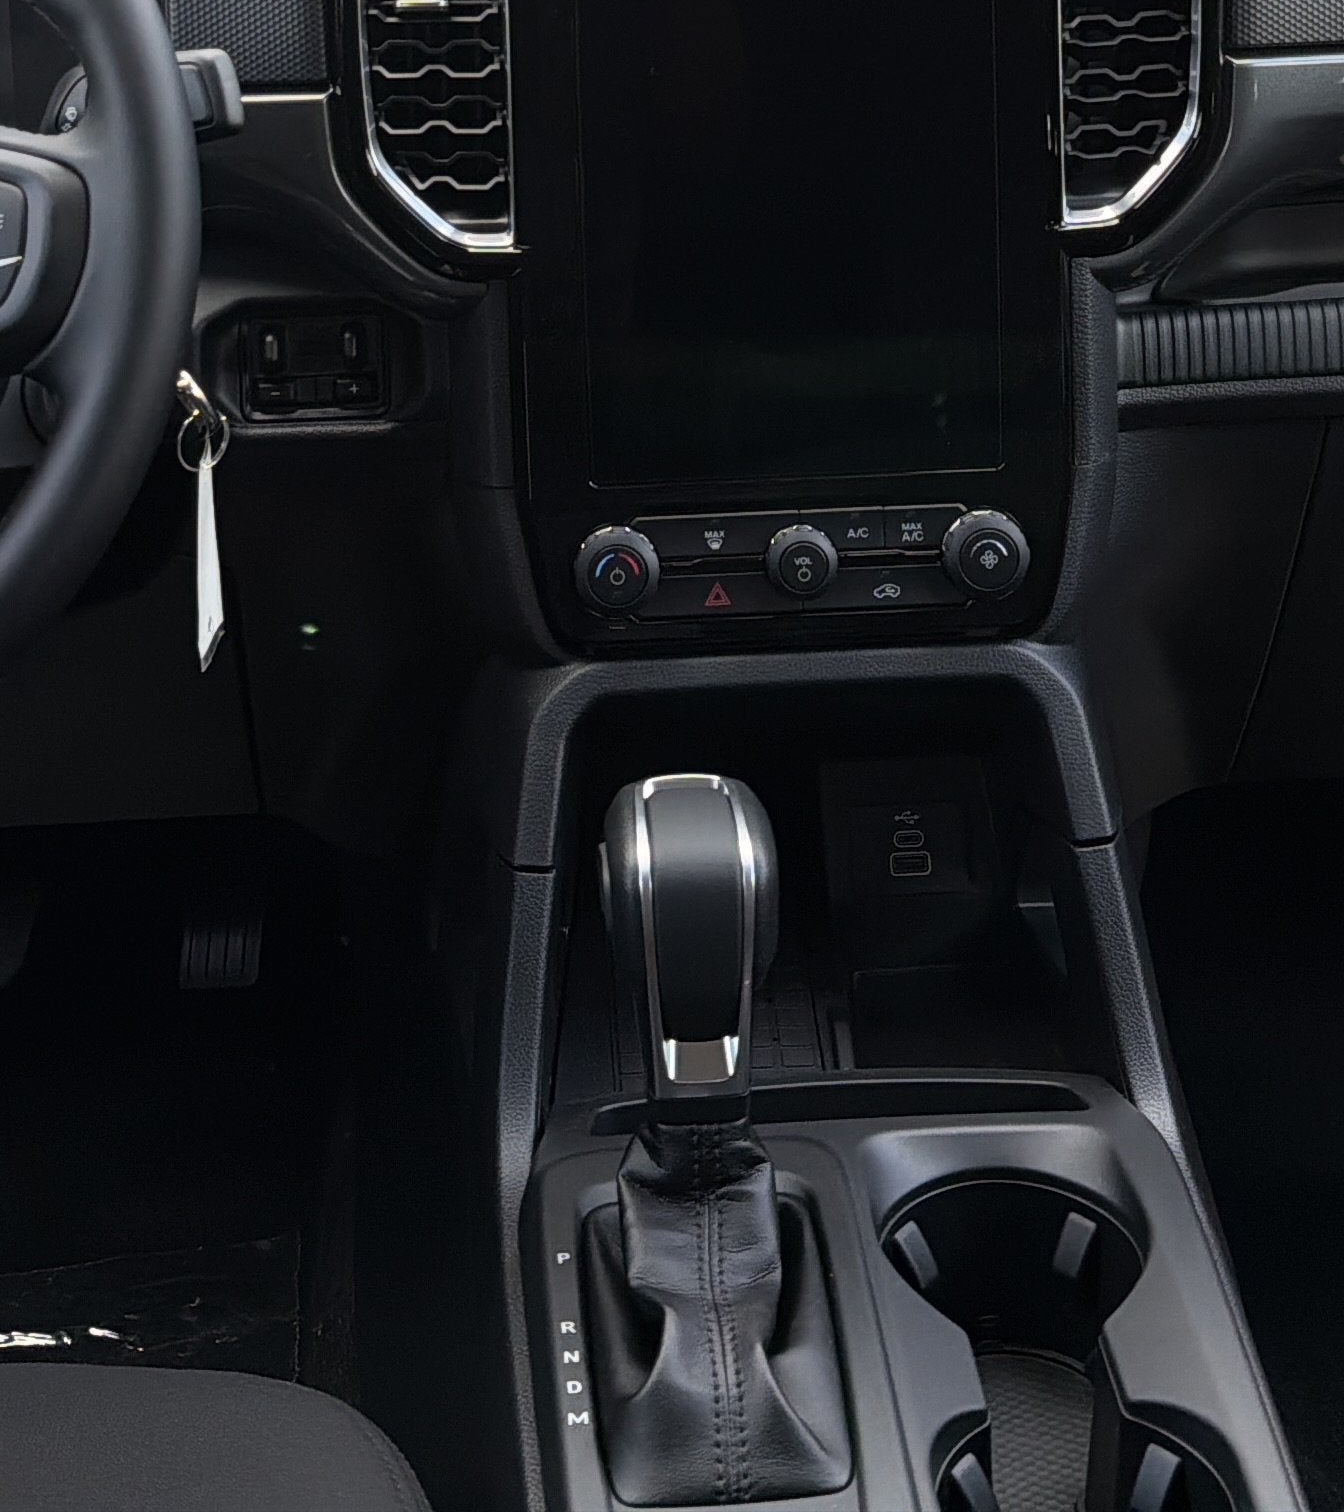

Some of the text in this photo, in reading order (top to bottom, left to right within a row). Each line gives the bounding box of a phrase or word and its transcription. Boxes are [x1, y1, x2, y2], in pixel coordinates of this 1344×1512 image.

[900, 522, 923, 532] MAX
[704, 530, 726, 539] MAX
[846, 527, 870, 540] A/C
[901, 531, 925, 543] A/C
[794, 557, 813, 567] VOL
[556, 1252, 590, 1426] P R N D M
